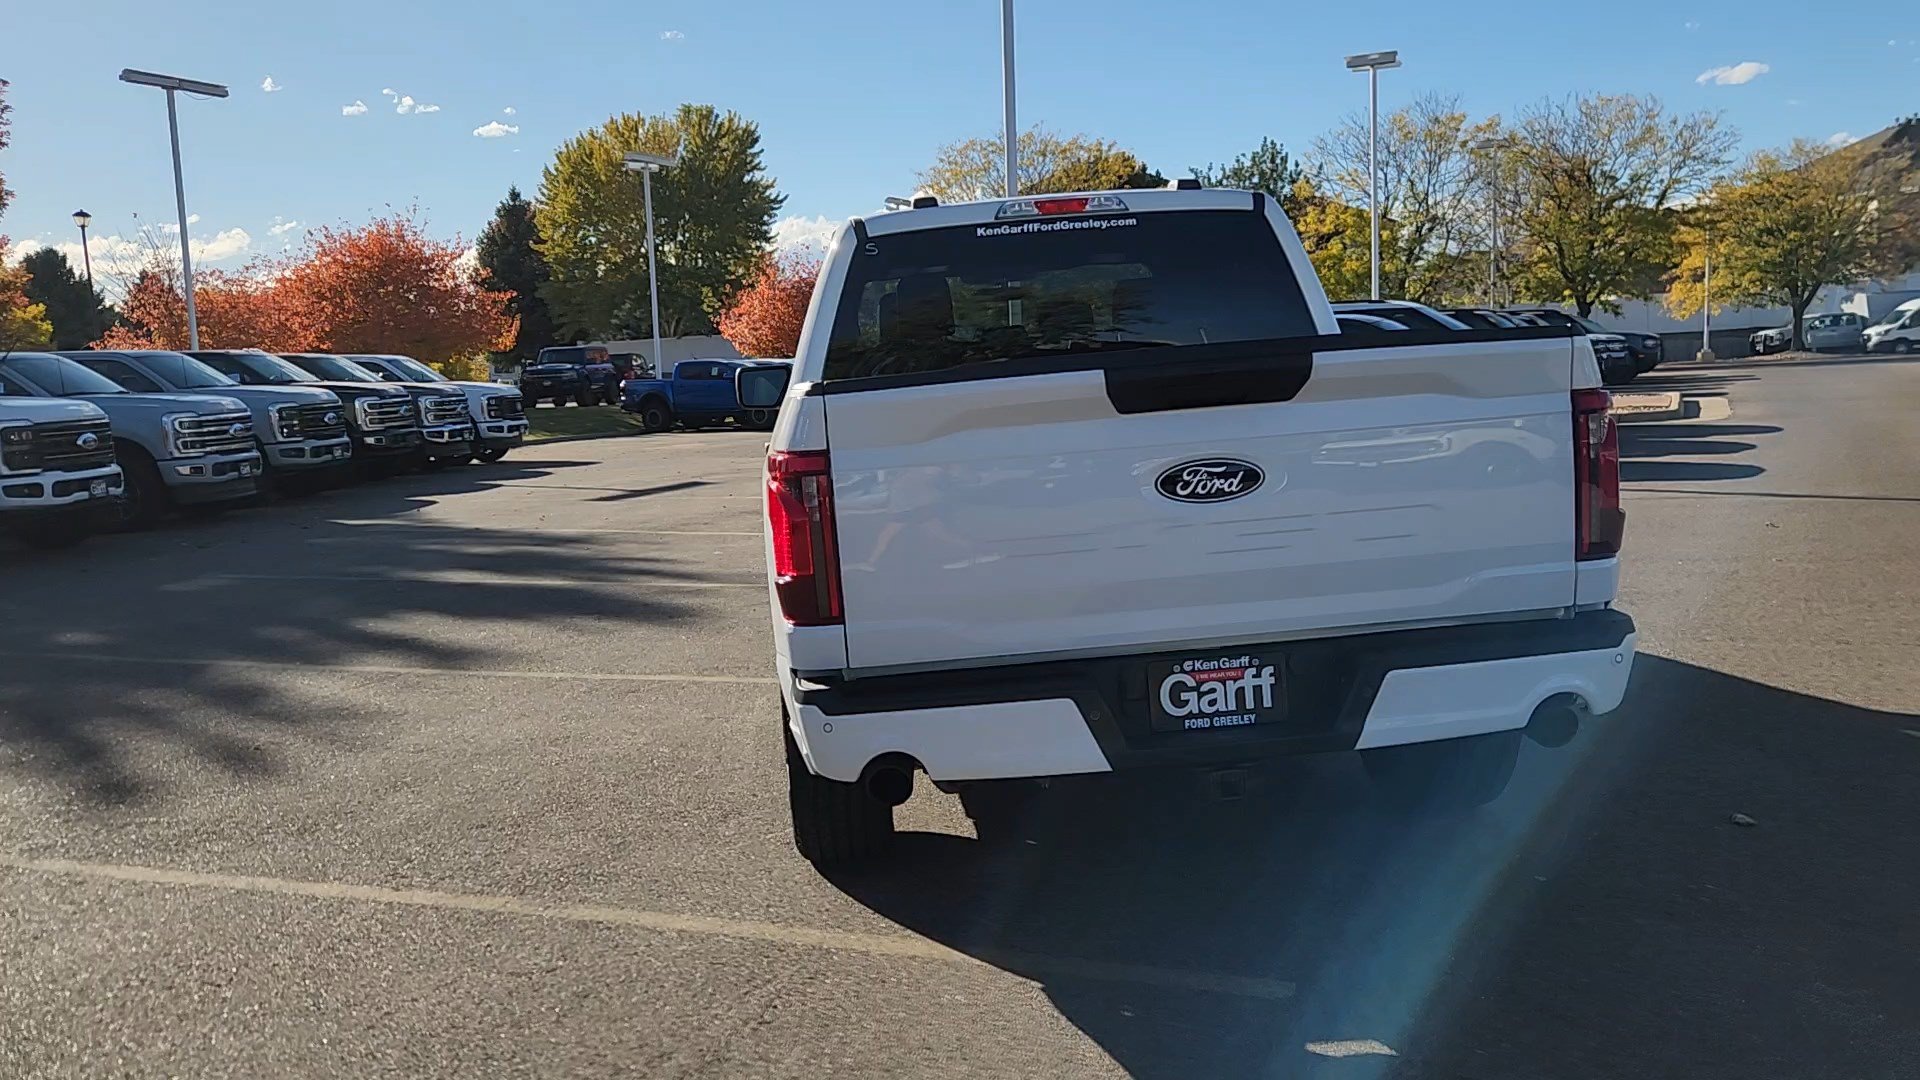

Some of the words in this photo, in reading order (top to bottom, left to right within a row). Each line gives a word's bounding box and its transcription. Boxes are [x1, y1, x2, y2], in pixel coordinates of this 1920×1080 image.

[976, 217, 1137, 237] KenGarffFordGreeley.com
[1176, 465, 1244, 496] Ford
[1194, 659, 1218, 671] Ken
[1219, 656, 1250, 668] Garff
[1160, 665, 1275, 717] Garff
[1184, 718, 1211, 730] FORD
[1212, 713, 1256, 727] GREELEY
